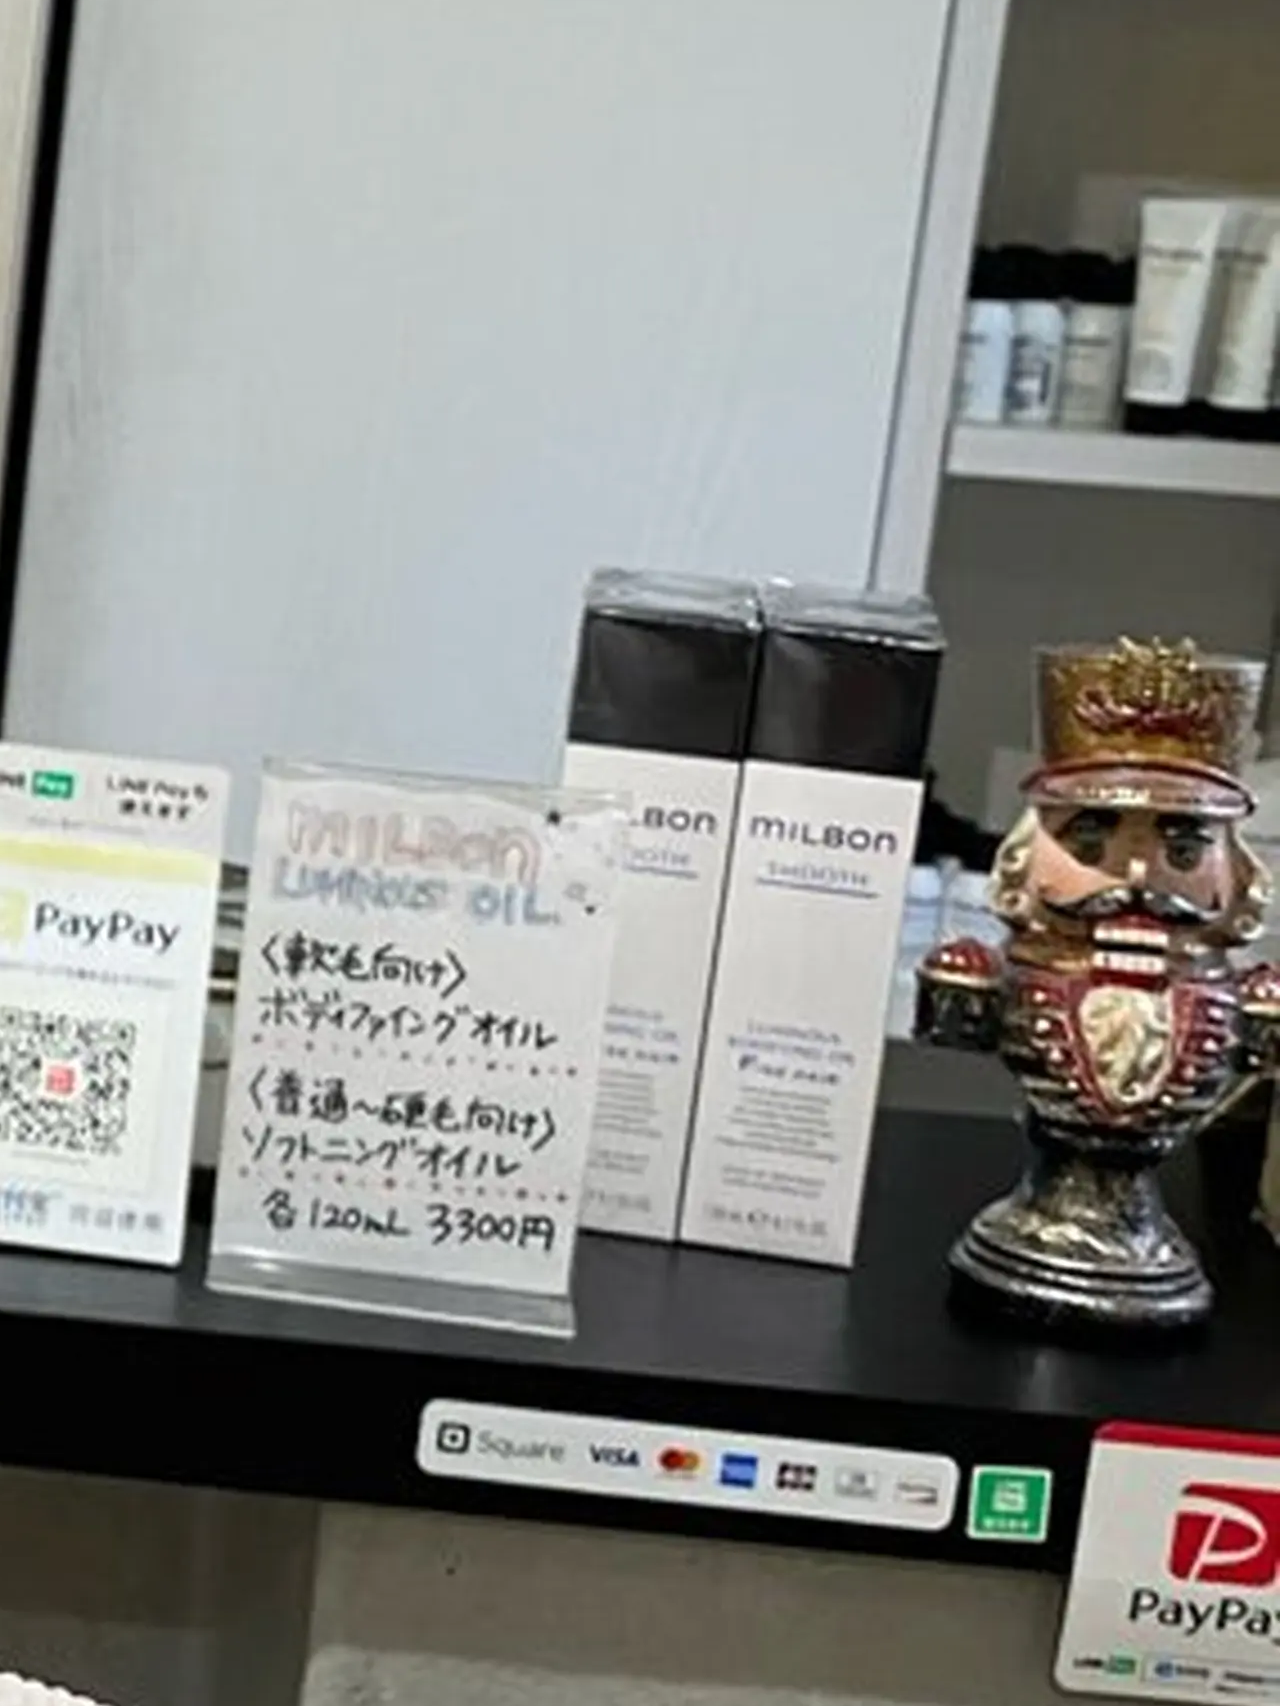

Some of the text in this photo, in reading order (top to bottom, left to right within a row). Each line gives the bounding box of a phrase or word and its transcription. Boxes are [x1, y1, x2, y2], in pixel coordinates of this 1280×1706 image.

[34, 901, 180, 955] PayPay
[425, 1201, 556, 1254] 3300円
[476, 1429, 566, 1463] Square
[589, 1444, 641, 1468] VISA
